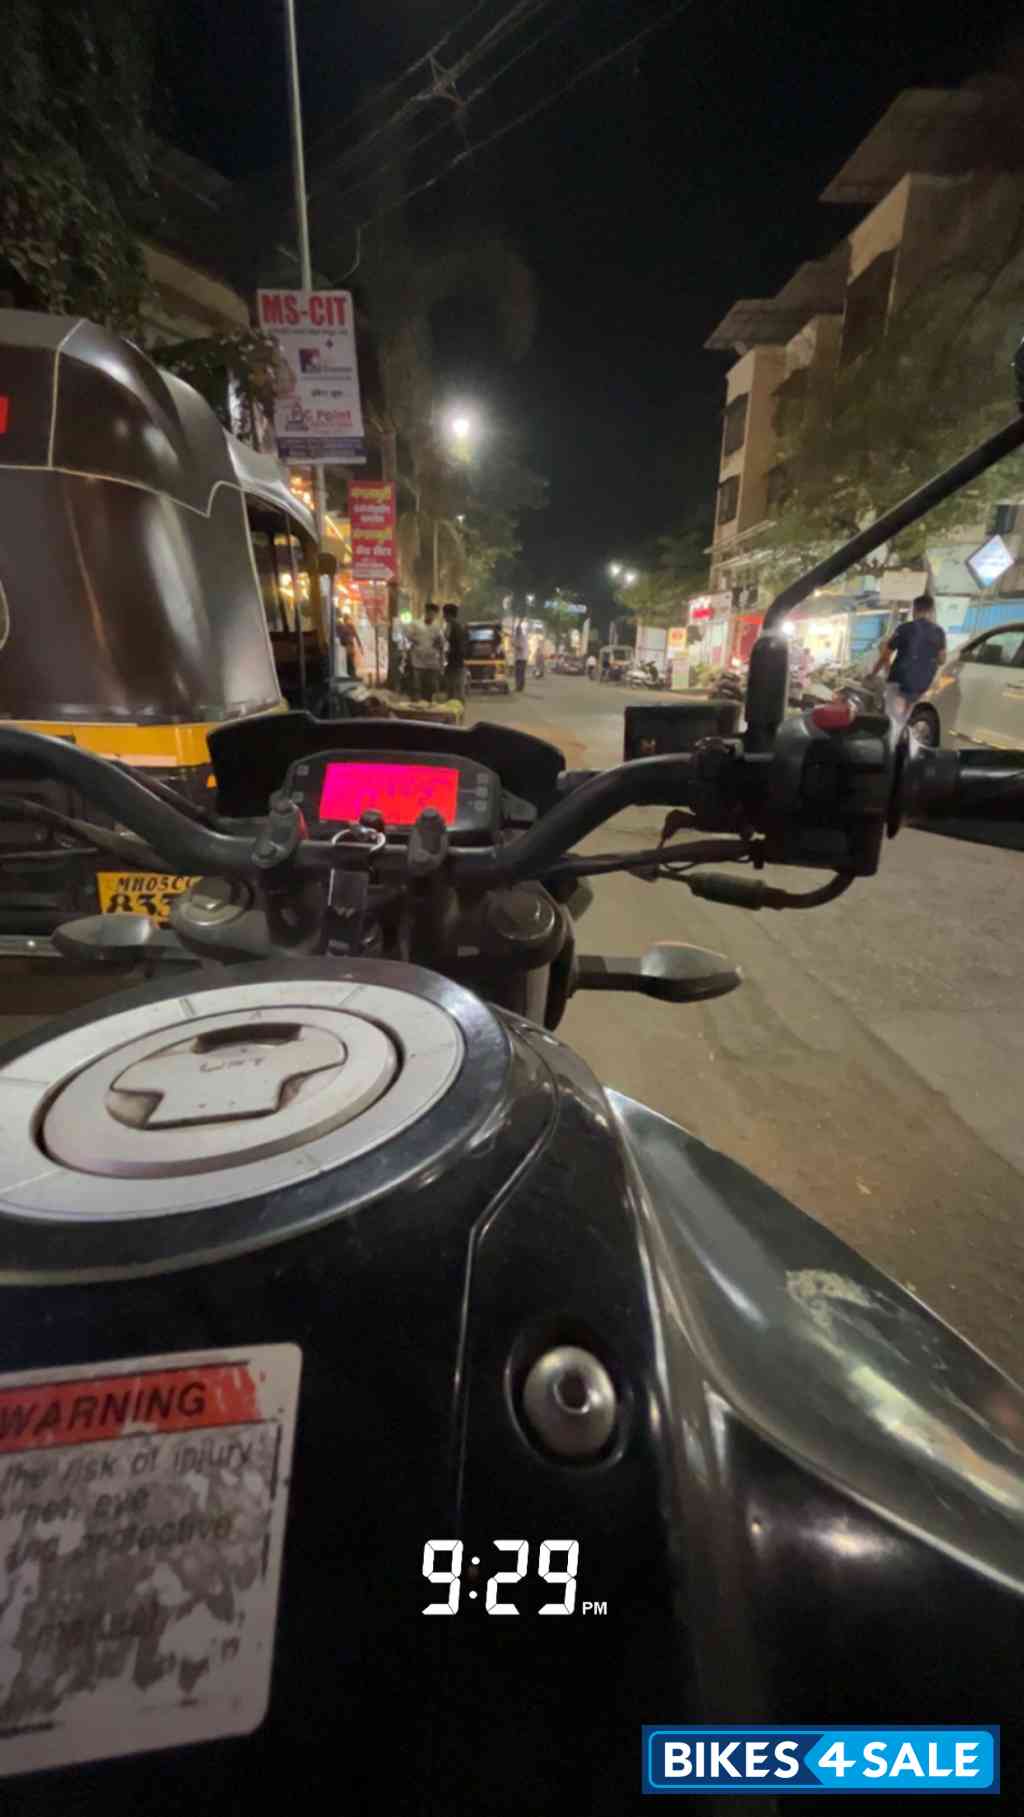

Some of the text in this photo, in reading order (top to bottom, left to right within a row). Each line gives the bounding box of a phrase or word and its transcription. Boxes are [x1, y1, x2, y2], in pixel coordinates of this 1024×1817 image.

[261, 295, 347, 327] MS-CIT
[0, 1380, 206, 1438] WARNING
[131, 1446, 158, 1475] of
[174, 1438, 253, 1474] injury
